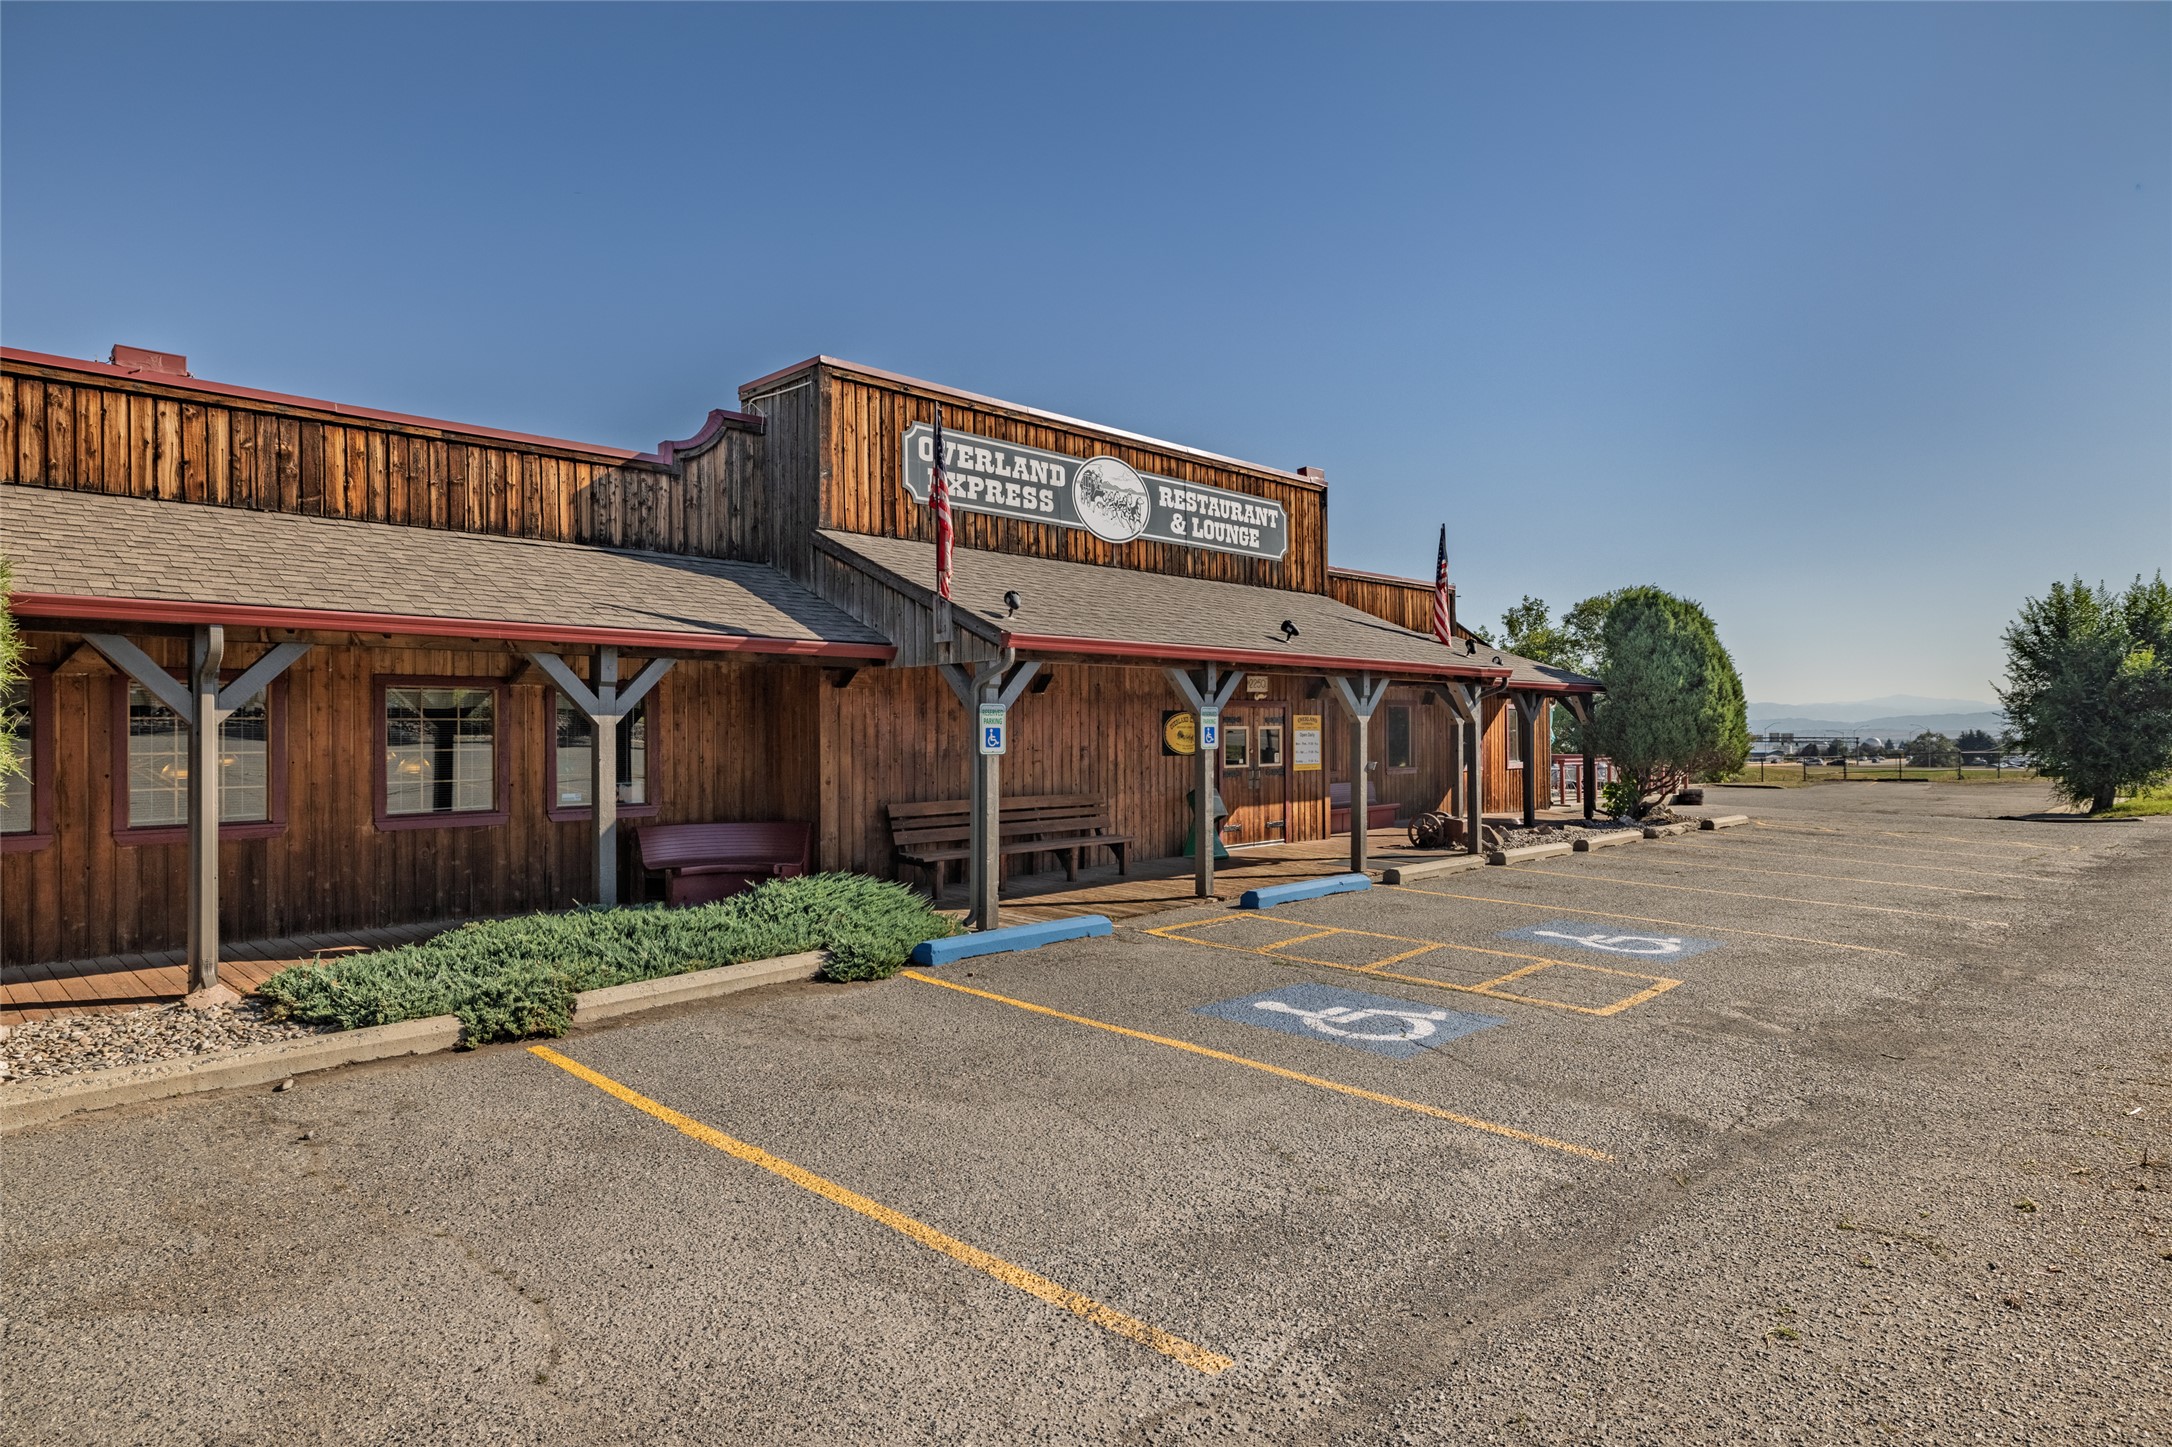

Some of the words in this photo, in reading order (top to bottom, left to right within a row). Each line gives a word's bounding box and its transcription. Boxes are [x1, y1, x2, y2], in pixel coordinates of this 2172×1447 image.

[1158, 485, 1279, 529] RESTAURANT
[1170, 512, 1187, 536] &
[1191, 516, 1260, 549] LOUNGE
